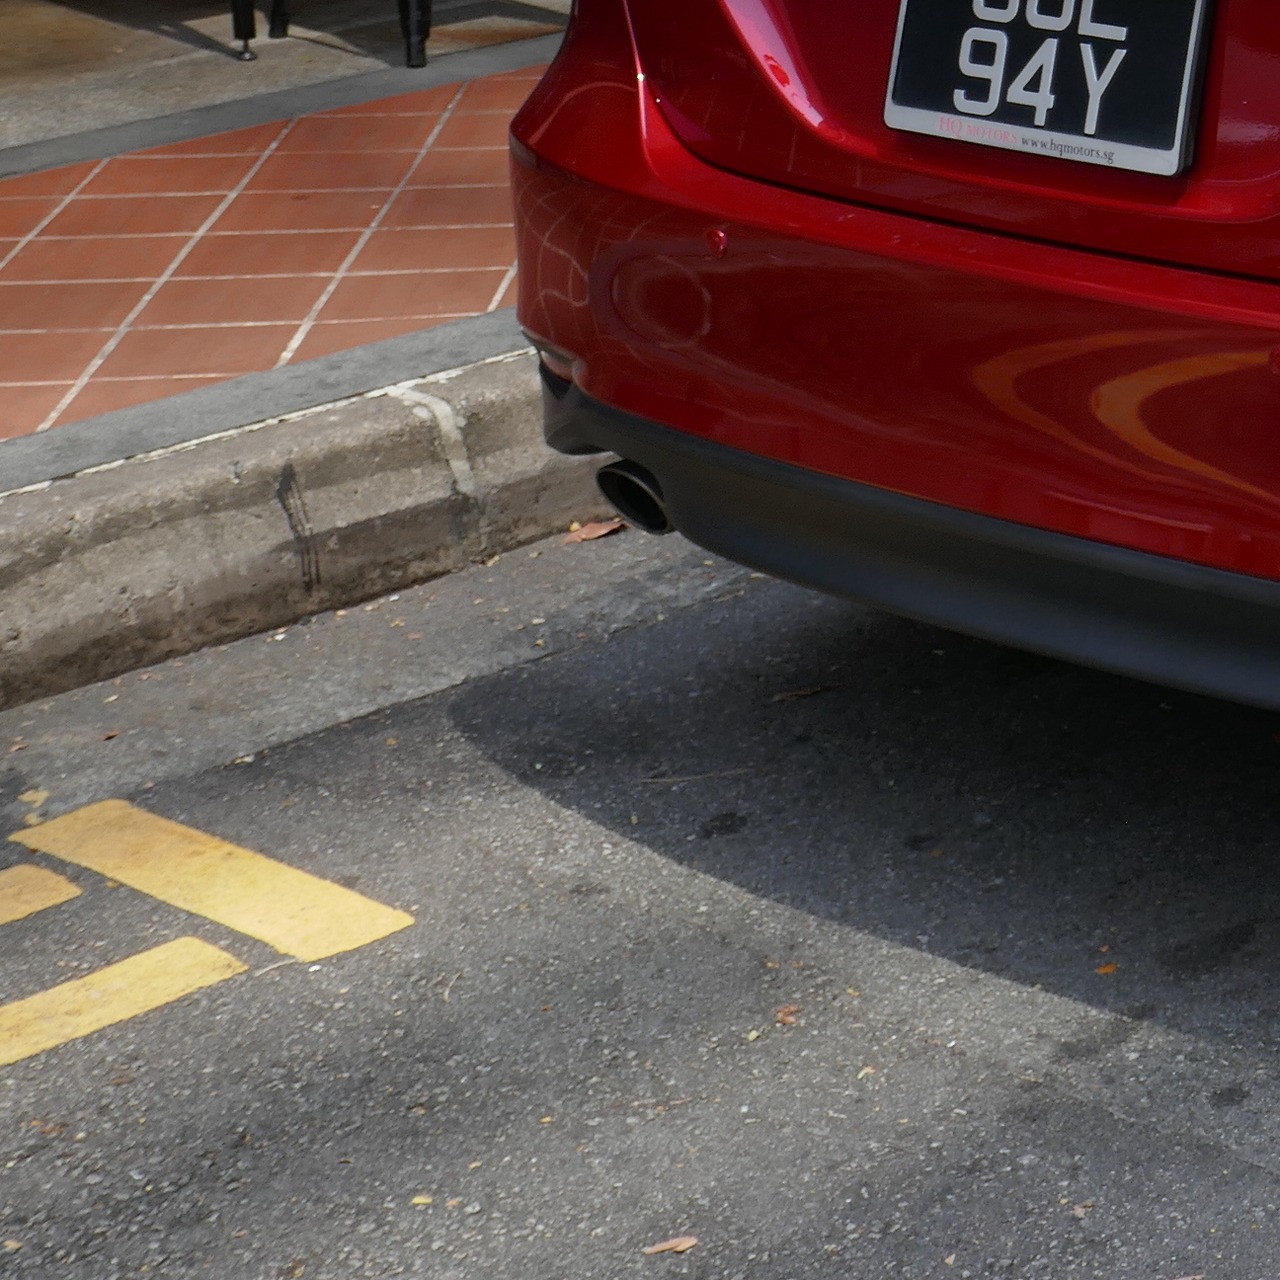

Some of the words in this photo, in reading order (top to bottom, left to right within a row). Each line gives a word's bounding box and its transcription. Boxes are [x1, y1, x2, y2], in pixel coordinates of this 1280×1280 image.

[936, 116, 963, 136] HQ
[965, 124, 1017, 144] MOTORS
[1021, 136, 1115, 164] www.hqmotors.sg
